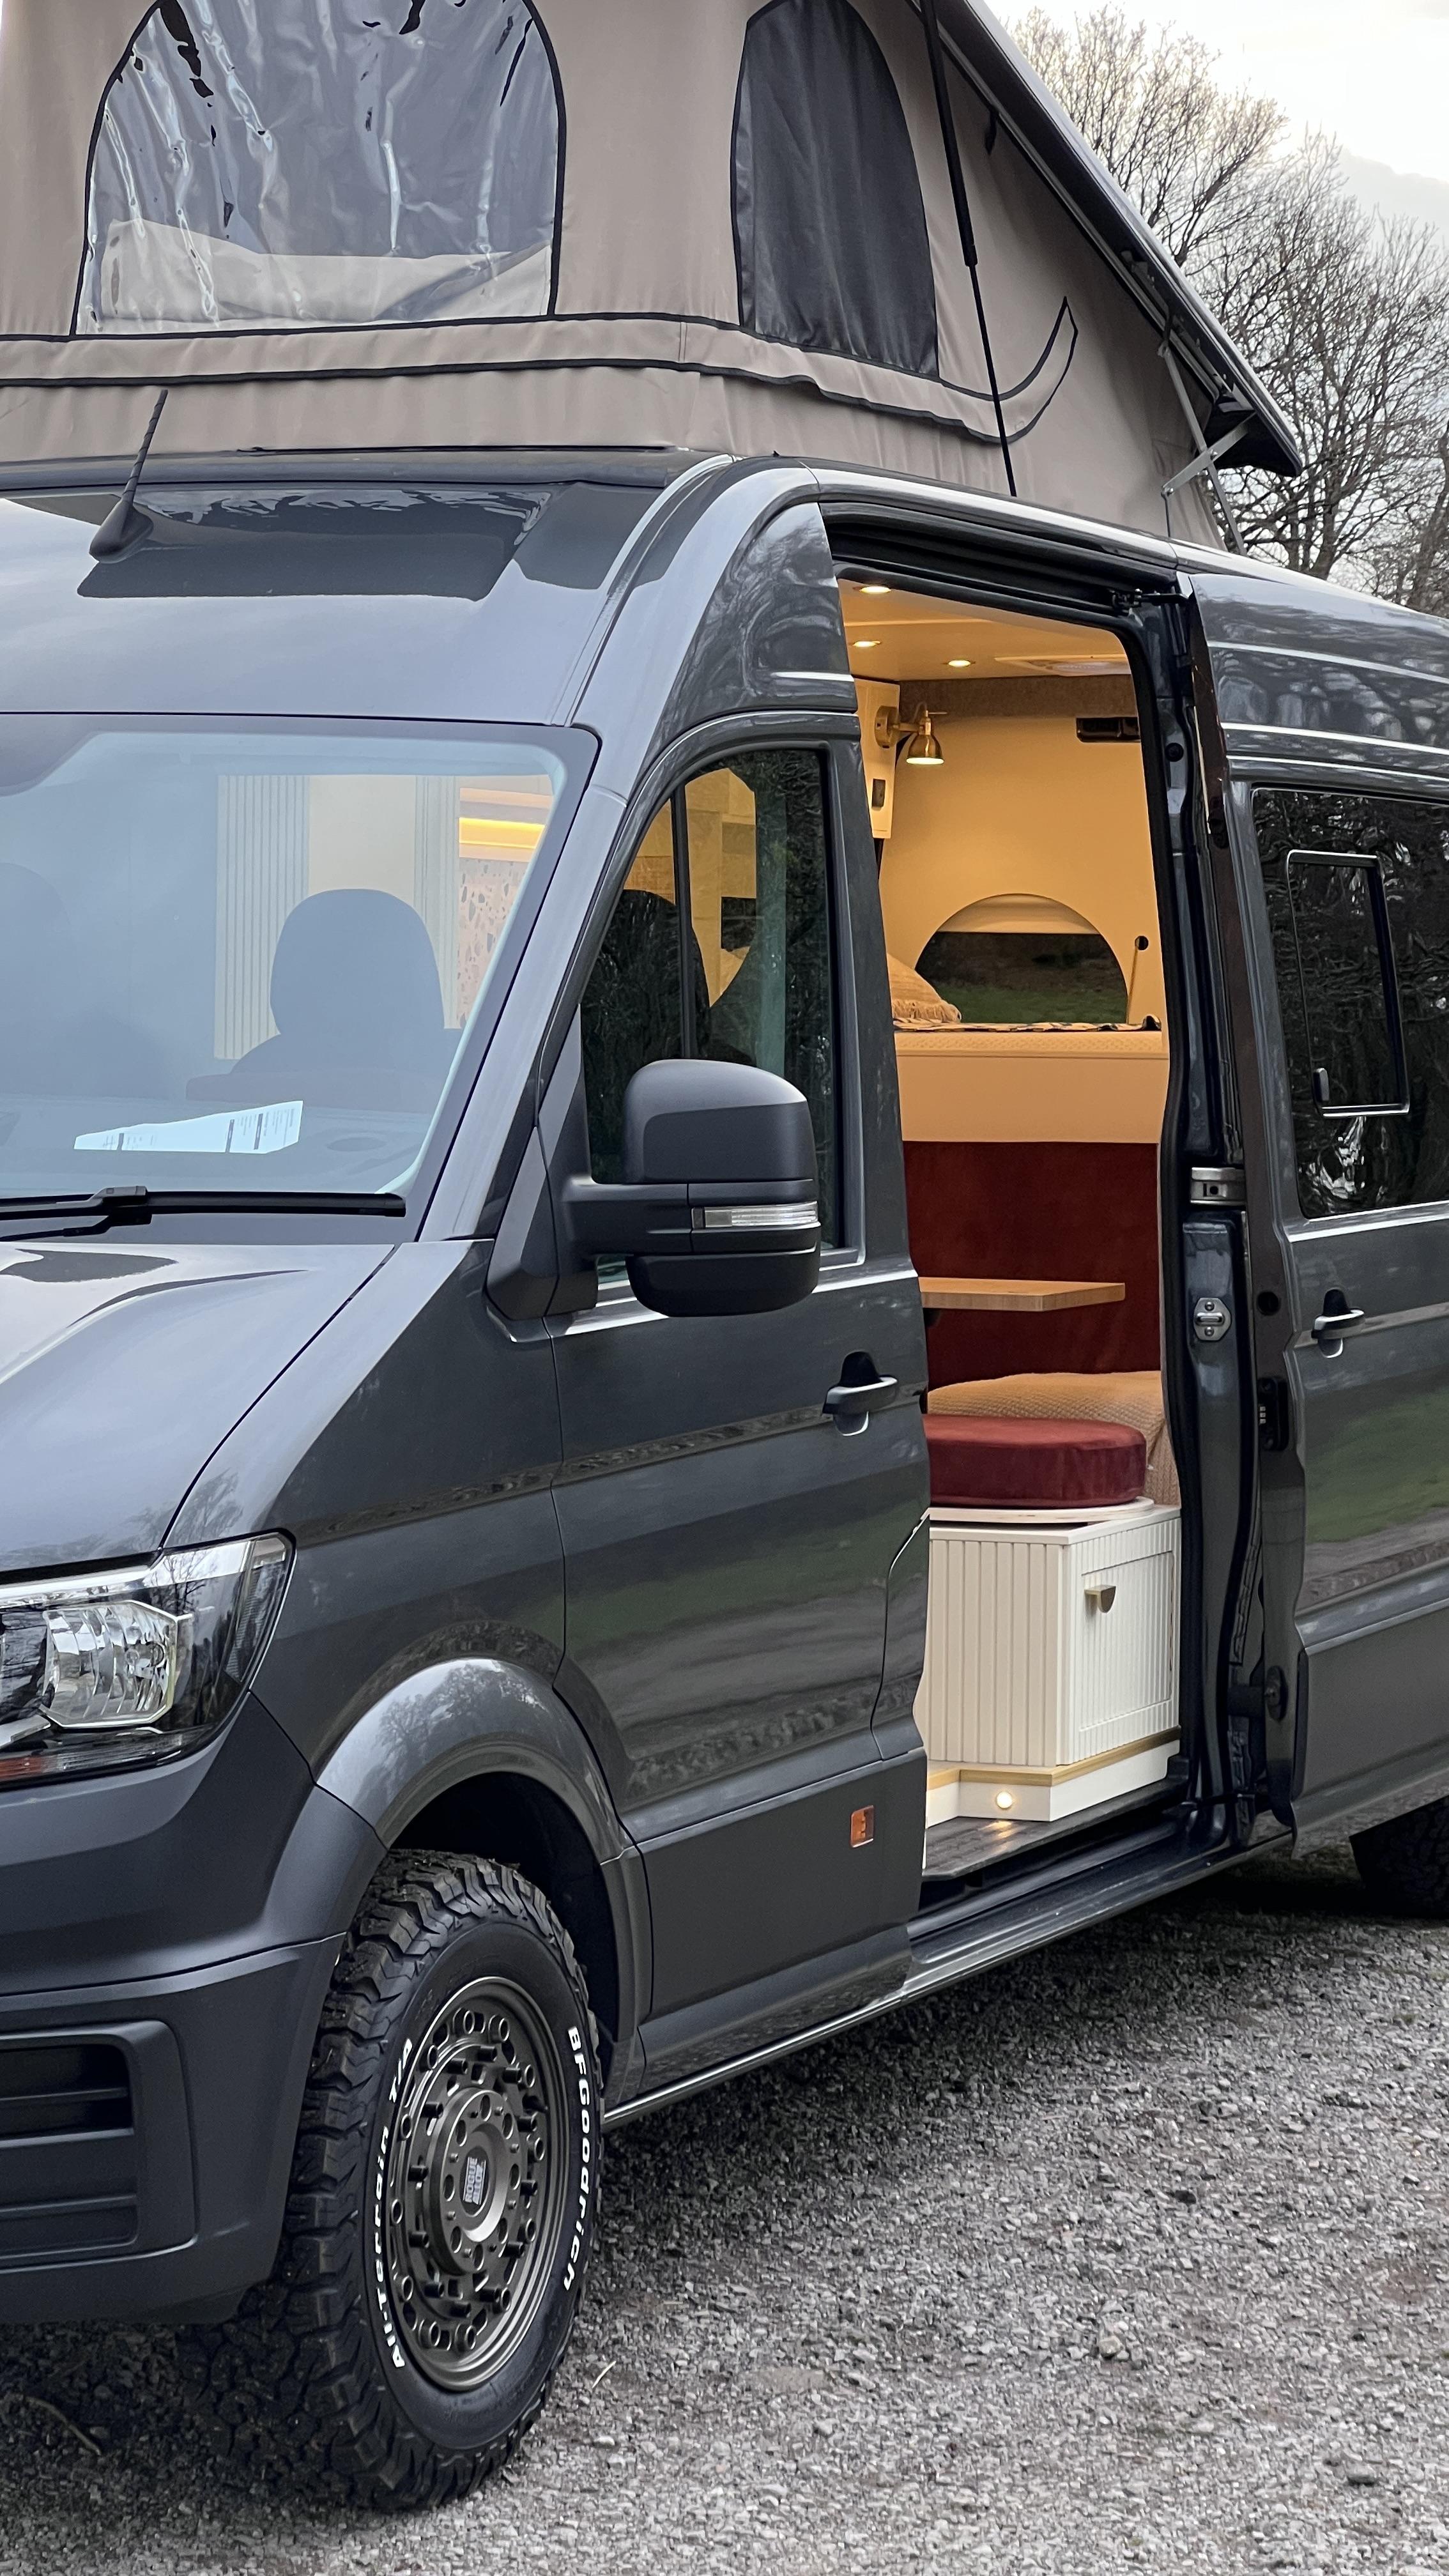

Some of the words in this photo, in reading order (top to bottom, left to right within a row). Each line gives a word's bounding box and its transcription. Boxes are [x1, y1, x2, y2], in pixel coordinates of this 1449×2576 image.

[388, 2038, 413, 2103] T/A
[464, 2156, 478, 2203] ROGUE
[564, 2026, 590, 2291] BFGoodrich
[374, 2126, 405, 2368] All-Terrain
